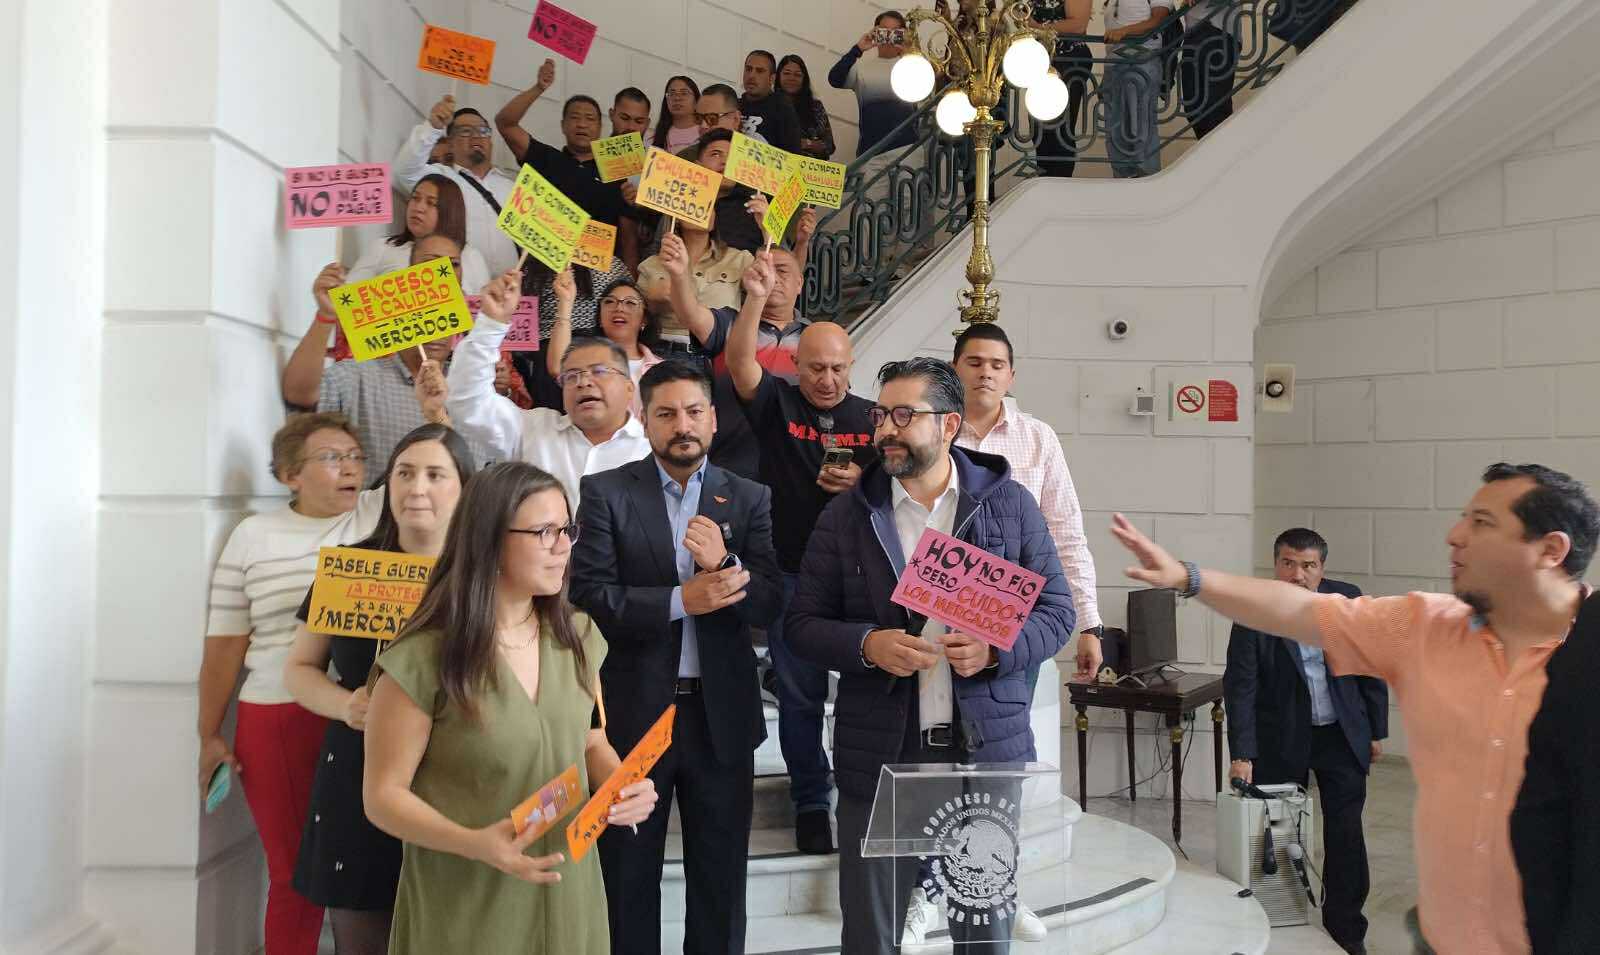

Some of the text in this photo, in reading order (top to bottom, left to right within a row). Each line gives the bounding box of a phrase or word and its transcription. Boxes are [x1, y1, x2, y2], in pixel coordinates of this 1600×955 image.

[809, 162, 840, 175] COMPRA
[512, 186, 535, 215] NO
[671, 180, 688, 195] DE
[805, 188, 839, 203] ERCADO
[291, 188, 381, 217] NO ME LO
[337, 201, 382, 214] PAGUE
[520, 221, 566, 263] MERCADO
[357, 267, 434, 305] EXCESO
[352, 305, 376, 324] DE
[381, 284, 450, 317] CALIDAD
[364, 312, 460, 352] MERCADOS
[323, 554, 432, 580] PÁSELE GÜERI
[924, 538, 1037, 597] HOY NO FÍO
[368, 582, 421, 600] PROTEG
[921, 566, 1016, 620] PERO CUIDO
[380, 602, 393, 613] SU
[902, 583, 1011, 637] LOS MERCADOS
[922, 792, 991, 836] CONGRESO
[955, 807, 990, 821] UNIDOS
